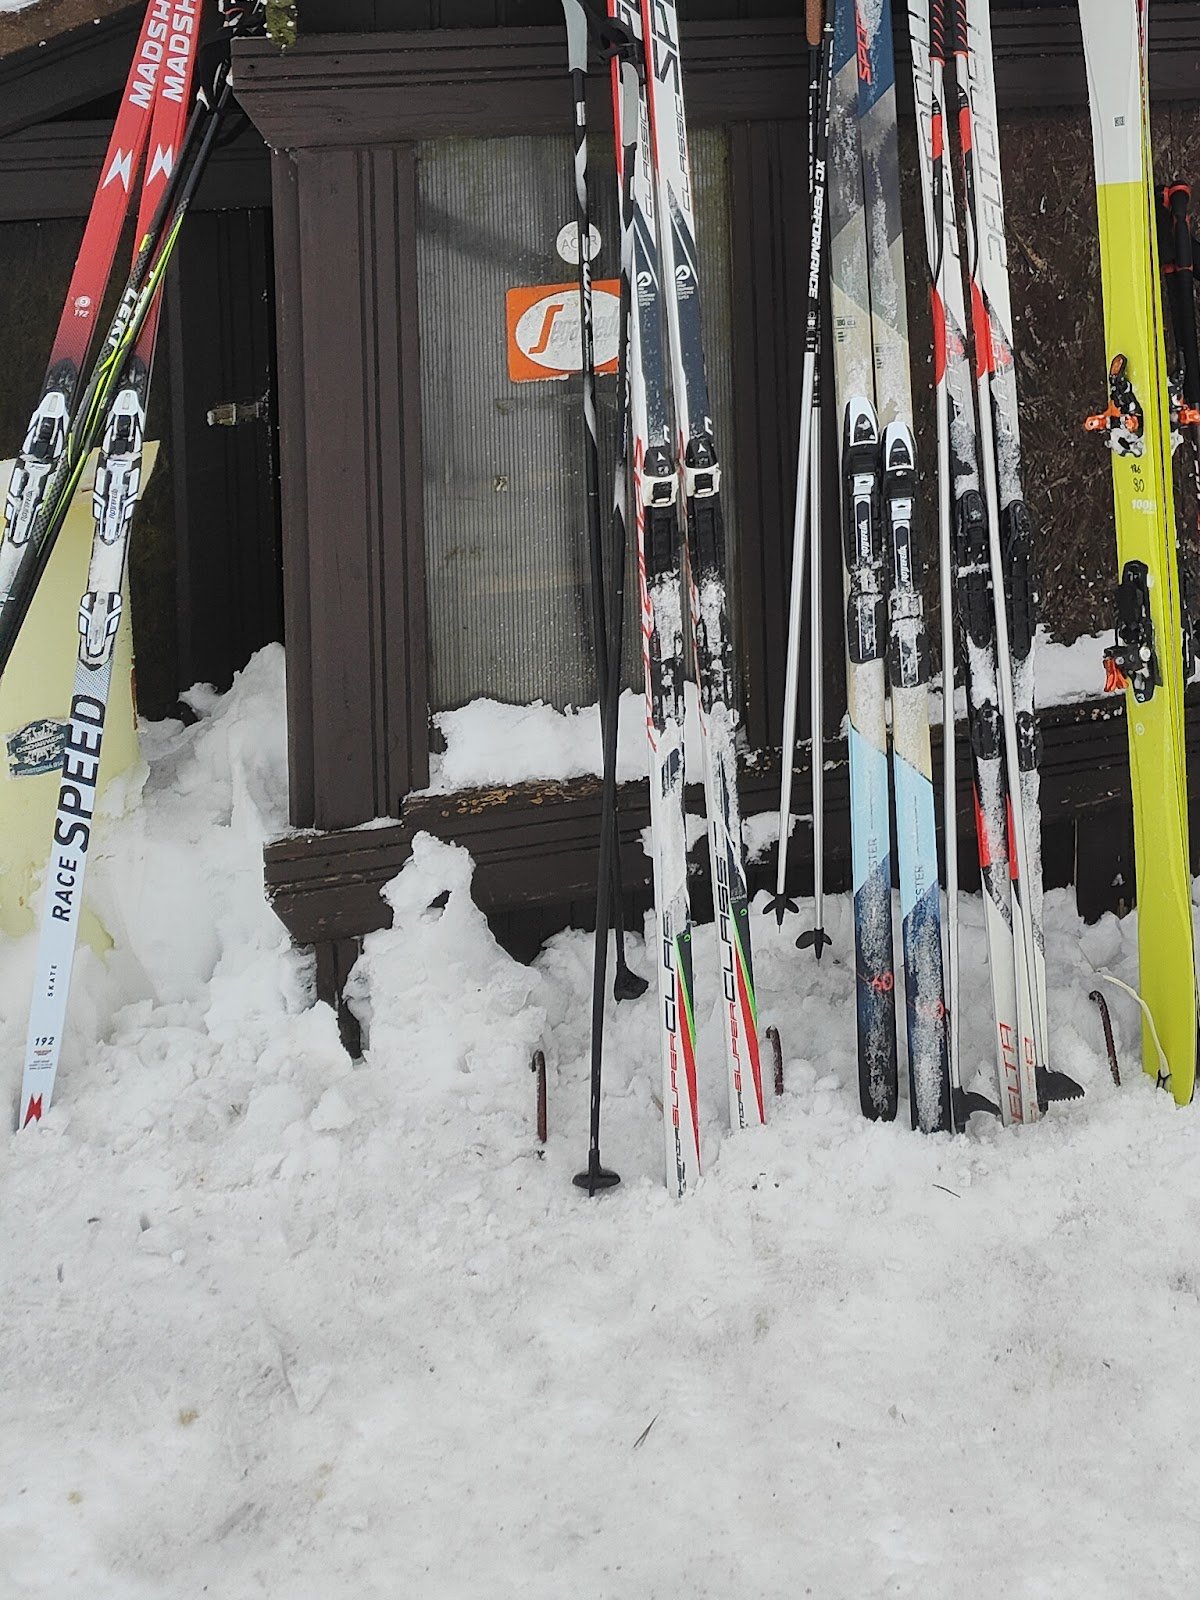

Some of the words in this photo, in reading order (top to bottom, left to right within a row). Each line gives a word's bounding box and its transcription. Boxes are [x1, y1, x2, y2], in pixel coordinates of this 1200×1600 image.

[674, 95, 691, 212] CLASSIC
[807, 184, 824, 300] PERFORMANCE
[108, 288, 138, 348] LEKI
[54, 694, 106, 853] SPEED
[52, 856, 77, 922] RACE
[47, 964, 57, 997] SKATE
[34, 1036, 55, 1046] 192
[669, 1032, 680, 1129] SUPER
[729, 1002, 742, 1093] SUPER
[999, 1022, 1023, 1123] ELTA
